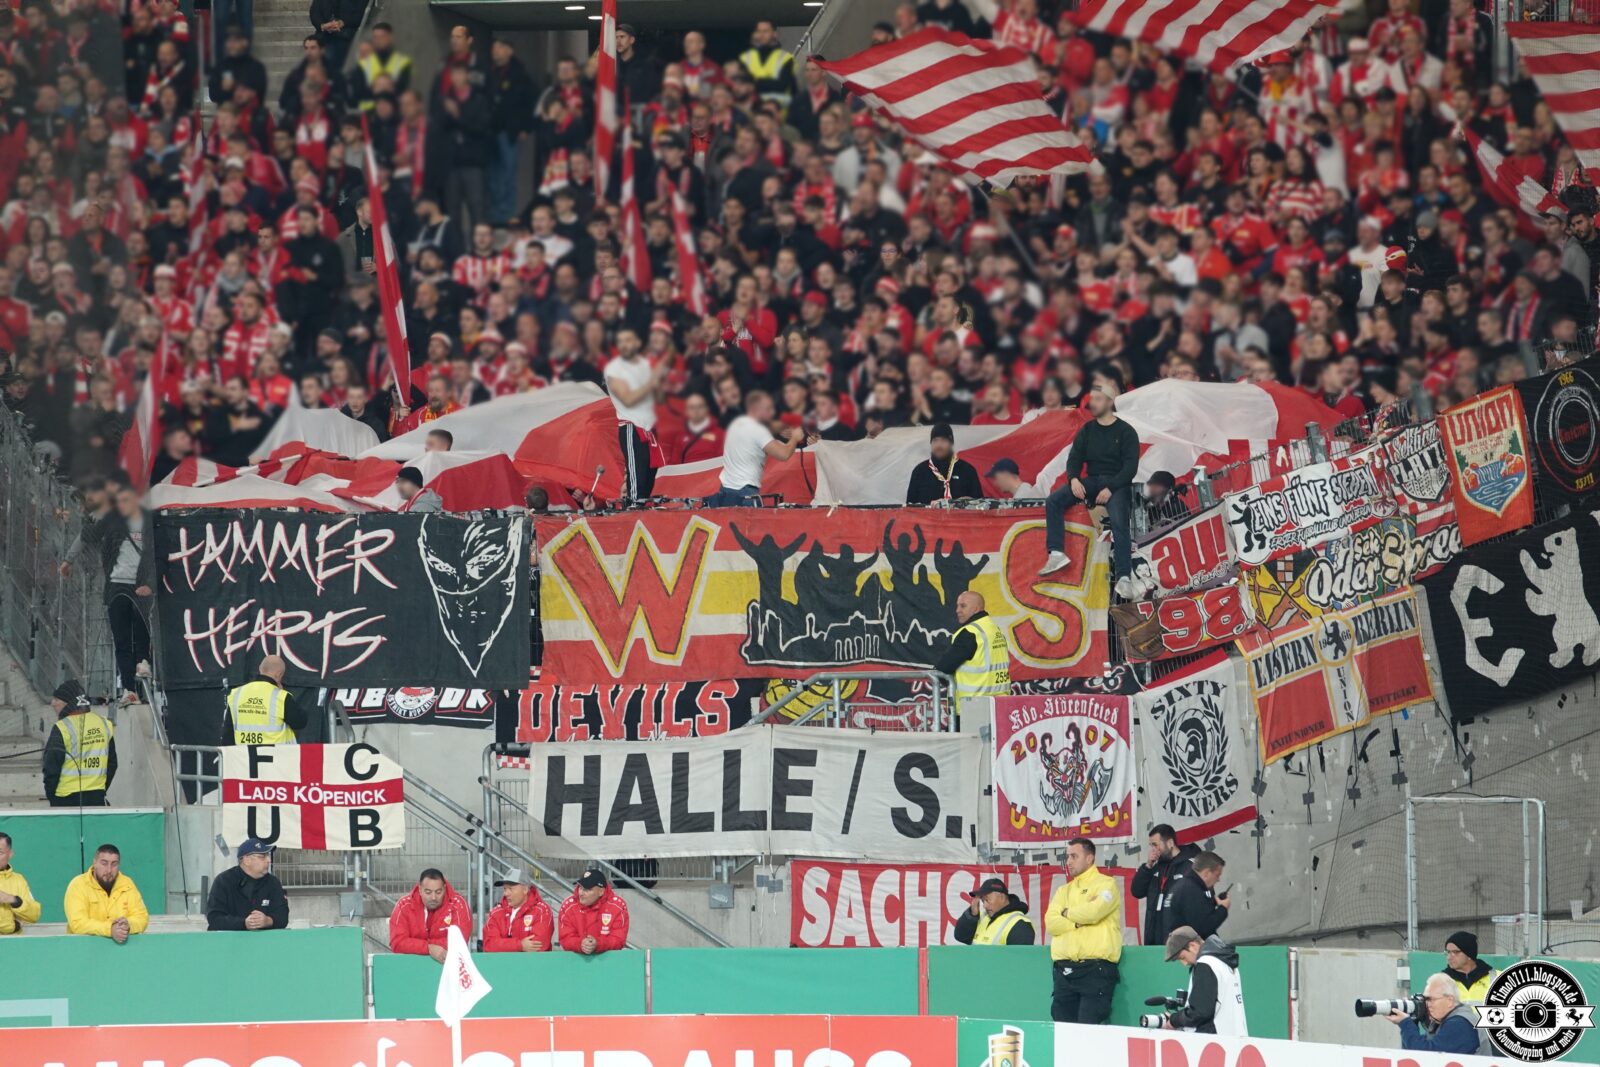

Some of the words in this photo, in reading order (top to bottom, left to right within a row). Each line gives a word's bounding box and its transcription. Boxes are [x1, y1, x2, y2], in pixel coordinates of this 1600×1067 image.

[1447, 394, 1514, 447] UNION
[1248, 493, 1285, 532] EINS
[1284, 475, 1330, 524] FÜNF
[1329, 463, 1380, 505] SIEBEN
[163, 517, 399, 597] HAMMER
[541, 513, 720, 678] W
[1000, 518, 1097, 668] S
[184, 599, 387, 679] HEARTS
[1253, 633, 1319, 689] EISERN
[1351, 598, 1418, 646] BERLIN
[247, 697, 263, 705] SDS
[515, 679, 739, 743] DEVILS
[1151, 680, 1228, 720] SIXTY
[1336, 667, 1355, 722] UNION
[84, 757, 100, 768] 1099
[240, 732, 264, 744] 2486
[247, 743, 275, 779] F
[344, 743, 380, 781] C
[1162, 772, 1239, 817] NINERS
[247, 806, 281, 845] U
[349, 808, 383, 848] B
